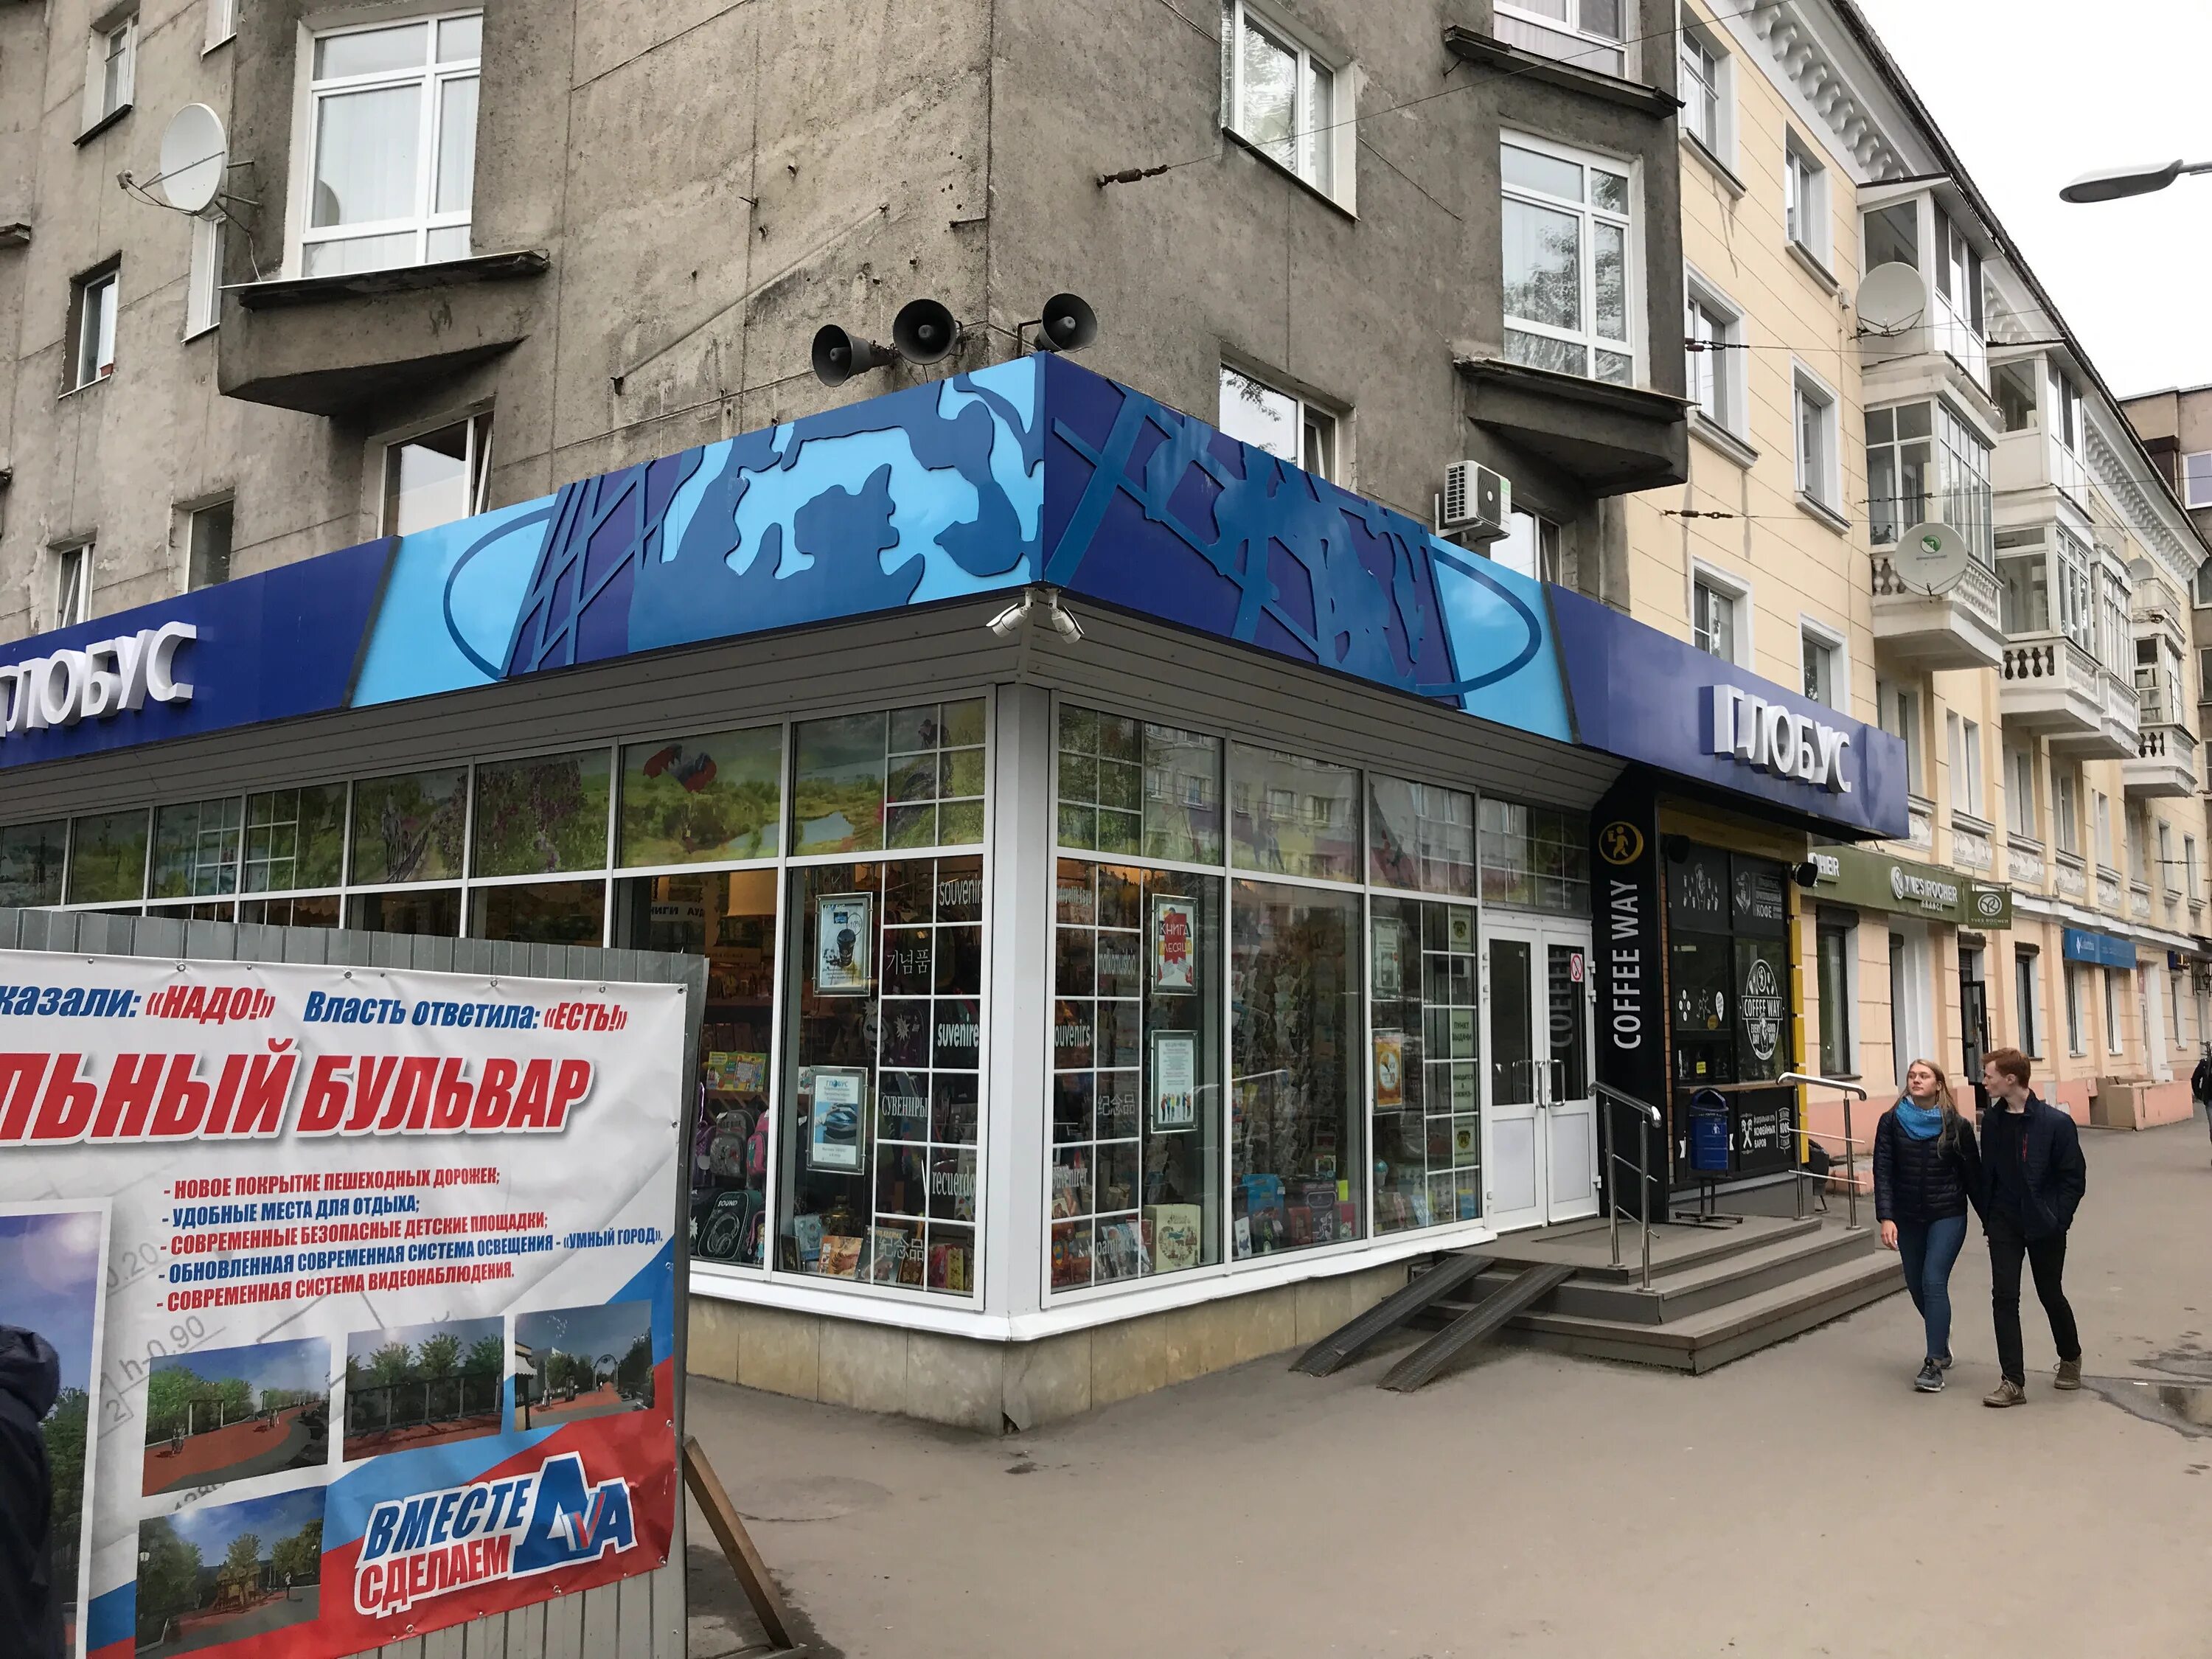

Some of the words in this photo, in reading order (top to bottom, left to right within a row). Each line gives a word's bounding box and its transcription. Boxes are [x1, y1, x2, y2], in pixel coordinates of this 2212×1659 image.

[1712, 684, 1851, 793] ГЛОБУС
[1904, 875, 1924, 896] YVES
[1927, 880, 1958, 902] ROCHER
[1610, 879, 1638, 940] WAY
[1160, 922, 1192, 937] КНИГА
[886, 949, 931, 975] 기념품
[145, 985, 276, 1025] «НАДО!»
[303, 991, 406, 1024] Власть
[411, 1001, 540, 1029] ответила:
[543, 1003, 627, 1032] «ЕСТЬ!»
[1612, 948, 1641, 1049] COFFEE
[1744, 998, 1766, 1018] COFFEE
[1767, 999, 1780, 1018] WAY
[937, 1012, 979, 1048] suvenire
[0, 1037, 296, 1139] ЛЬНЫЙ
[296, 1056, 588, 1131] БУЛЬВАР
[882, 1096, 928, 1118] СУВЕНИРЫ
[1098, 1094, 1135, 1116] 纪念品
[174, 1178, 232, 1199] НОВОЕ
[234, 1173, 321, 1195] ПОКРЫТИЕ
[324, 1169, 431, 1192] ПЕШЕХОДНЫХ
[433, 1167, 500, 1189] ДОРОЖЕК;
[172, 1203, 257, 1230] УДОБНЫЕ
[260, 1200, 313, 1221] МЕСТА
[315, 1198, 349, 1220] ДЛЯ
[353, 1194, 420, 1216] ОТДЫХА;
[717, 1200, 738, 1208] SOUND
[170, 1227, 298, 1255] СОВРЕМЕННЫЕ
[301, 1220, 402, 1245] БЕЗОПАСНЫЕ
[404, 1216, 468, 1239] ДЕТСКИЕ
[470, 1211, 548, 1233] ПЛОЩАДКИ;
[879, 1237, 924, 1262] 纪念品
[169, 1254, 294, 1283] ОБНОВЛЕННАЯ
[298, 1245, 405, 1271] СОВРЕМЕННАЯ
[408, 1240, 475, 1262] СИСТЕМА
[477, 1235, 553, 1257] ОСВЕЩЕНИЯ
[563, 1228, 615, 1249] «УМНЫЙ
[617, 1227, 663, 1246] ГОРОД».
[167, 1281, 292, 1312] СОВРЕМЕННАЯ
[296, 1274, 365, 1298] СИСТЕМА
[368, 1262, 514, 1291] ВИДЕОНАБЛЮДЕНИЯ.
[364, 1478, 534, 1561] ВМЕСТЕ
[360, 1534, 512, 1612] СДЕЛАЕМ
